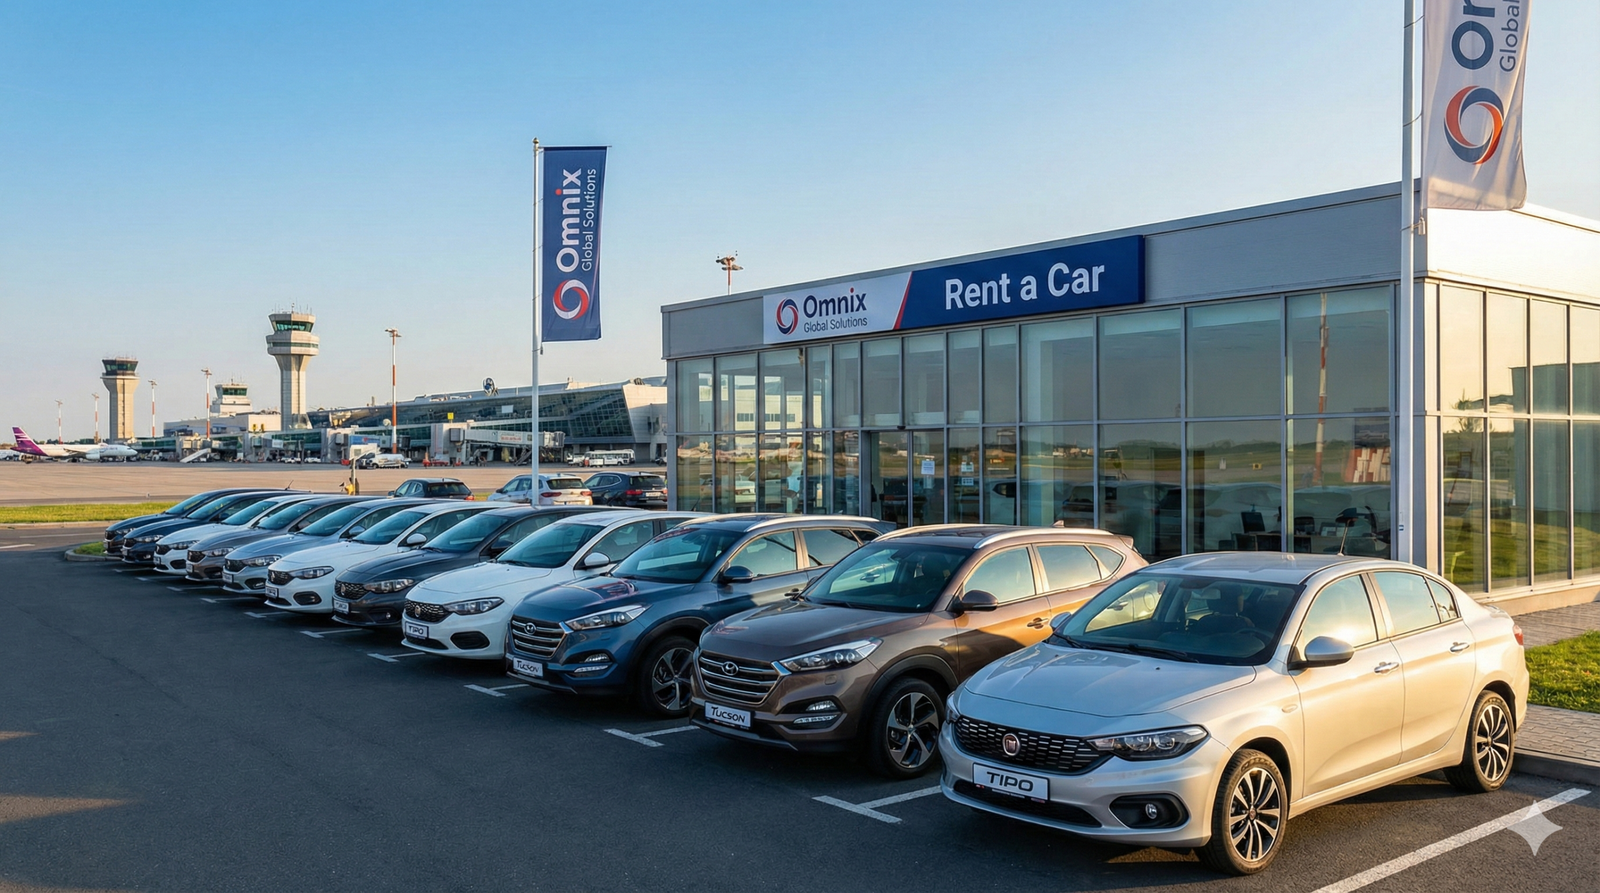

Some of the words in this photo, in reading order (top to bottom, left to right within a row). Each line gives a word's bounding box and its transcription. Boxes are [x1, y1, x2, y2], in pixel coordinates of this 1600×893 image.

[583, 168, 597, 228] Solutions
[555, 168, 582, 273] Omnix
[581, 231, 594, 272] Global
[803, 287, 867, 318] Omnix
[945, 273, 1011, 310] Rent
[1020, 275, 1038, 301] a
[1047, 262, 1105, 297] Car
[803, 319, 828, 333] Global
[829, 317, 868, 330] Solutions
[986, 771, 1034, 792] TIPO
